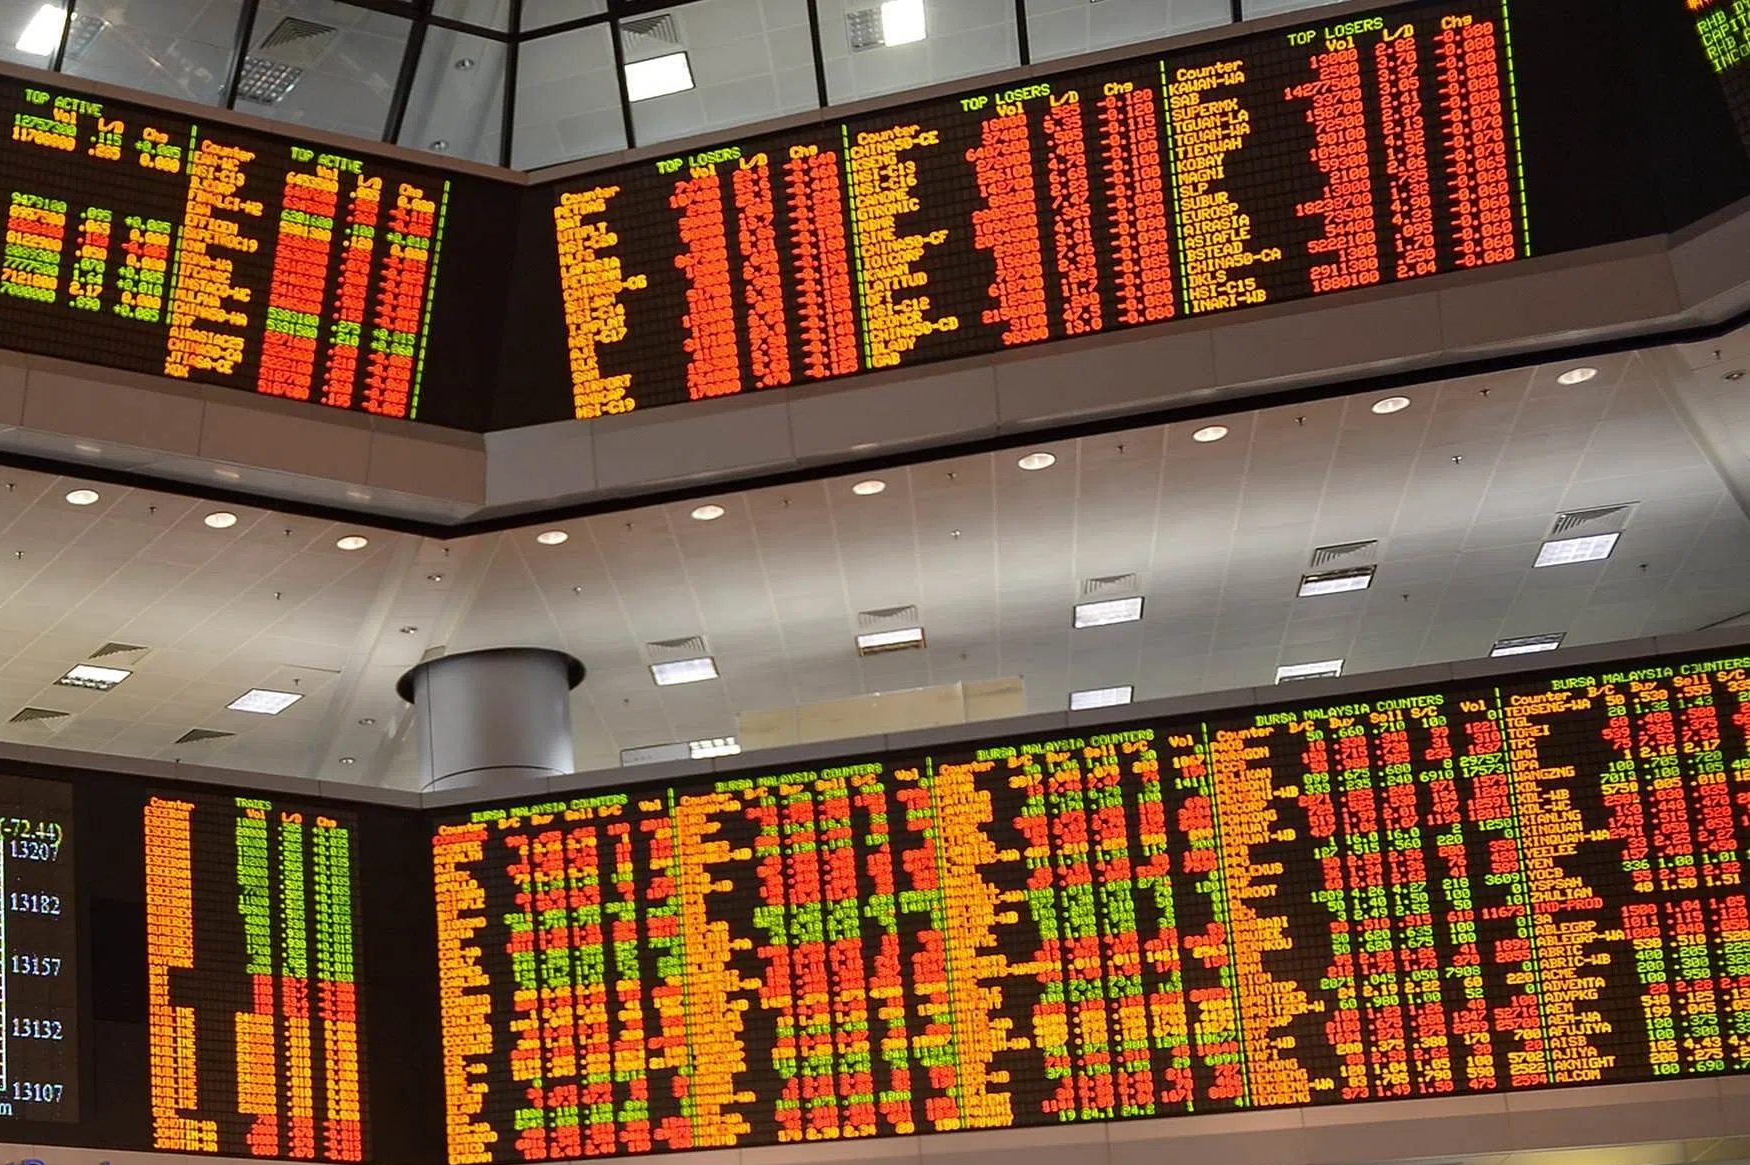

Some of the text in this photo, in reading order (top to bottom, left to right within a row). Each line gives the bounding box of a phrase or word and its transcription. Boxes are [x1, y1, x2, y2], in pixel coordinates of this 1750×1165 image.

[1287, 17, 1384, 46] TOP LOSERS
[1325, 15, 1472, 51] Vol Chg
[1697, 10, 1727, 35] RHB
[1707, 36, 1736, 60] RHB
[1176, 59, 1244, 82] Counter
[1169, 71, 1245, 95] KAWAN-WA
[1170, 93, 1199, 108] SAB
[1171, 75, 1361, 121] SUPERMX 14277500
[1173, 110, 1249, 134] TGUAN-LA
[1175, 123, 1251, 147] TGUAN-WA
[1175, 137, 1242, 158] TIENWAH
[1177, 153, 1224, 172] KOBAY
[1180, 192, 1229, 210] SUBUR
[1182, 203, 1239, 224] EUROSP
[1183, 215, 1250, 238] AIRASIA
[1184, 227, 1251, 249] ASIAFLE
[1187, 241, 1244, 261] BSTEAD
[1187, 232, 1377, 274] CHINA50-CA 5222100
[1190, 278, 1256, 299] HSI-C15
[1192, 247, 1514, 313] INARI-WB 1880100 2.04 -0.060
[1552, 667, 1673, 690] BURSA MALAYSIA
[1256, 695, 1444, 726] BURSA MALAYSIA COUNTERS
[1504, 695, 1625, 717] TEOSENG-WA 50
[1216, 700, 1487, 741] Counter Vol
[1514, 761, 1635, 782] WANGZNG 100
[234, 798, 271, 811] TRADES
[10, 839, 58, 861] 13207
[10, 895, 61, 915] 13182
[1538, 945, 1583, 959] ABRIC
[11, 958, 61, 976] 13157
[1542, 977, 1606, 992] ADVENTA
[12, 1020, 64, 1040] 13132
[1549, 1022, 1612, 1037] AFUJIYA
[1554, 1056, 1615, 1072] AKNIGHT
[1555, 1060, 1725, 1082] ALCOM 100 .690
[12, 1082, 64, 1103] 13107
